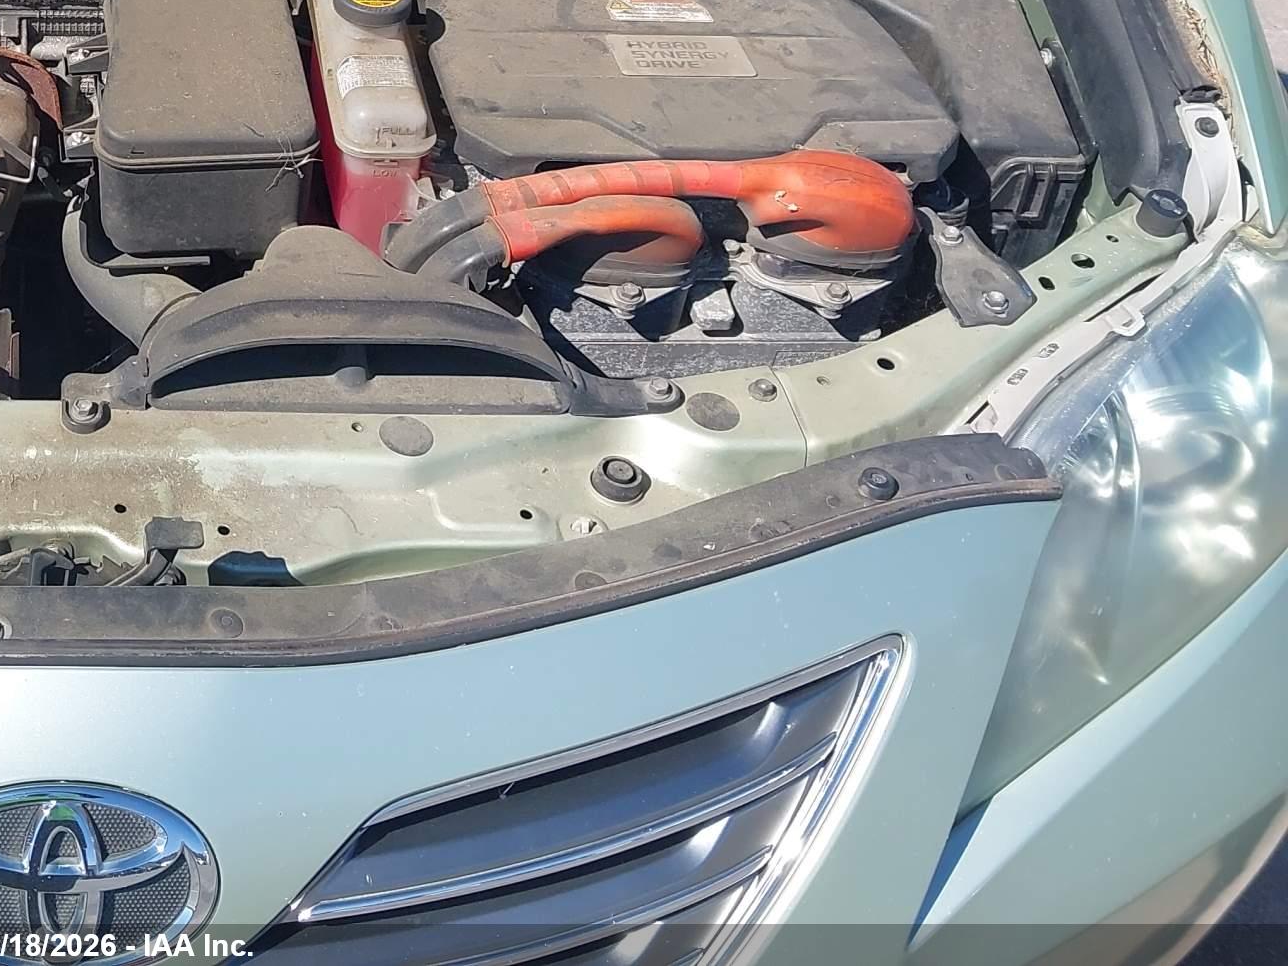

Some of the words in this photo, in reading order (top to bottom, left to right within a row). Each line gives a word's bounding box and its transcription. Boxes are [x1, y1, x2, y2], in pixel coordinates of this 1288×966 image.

[626, 40, 708, 50] HYBRID
[631, 50, 730, 60] SYNERGY
[635, 59, 702, 69] DRIVE
